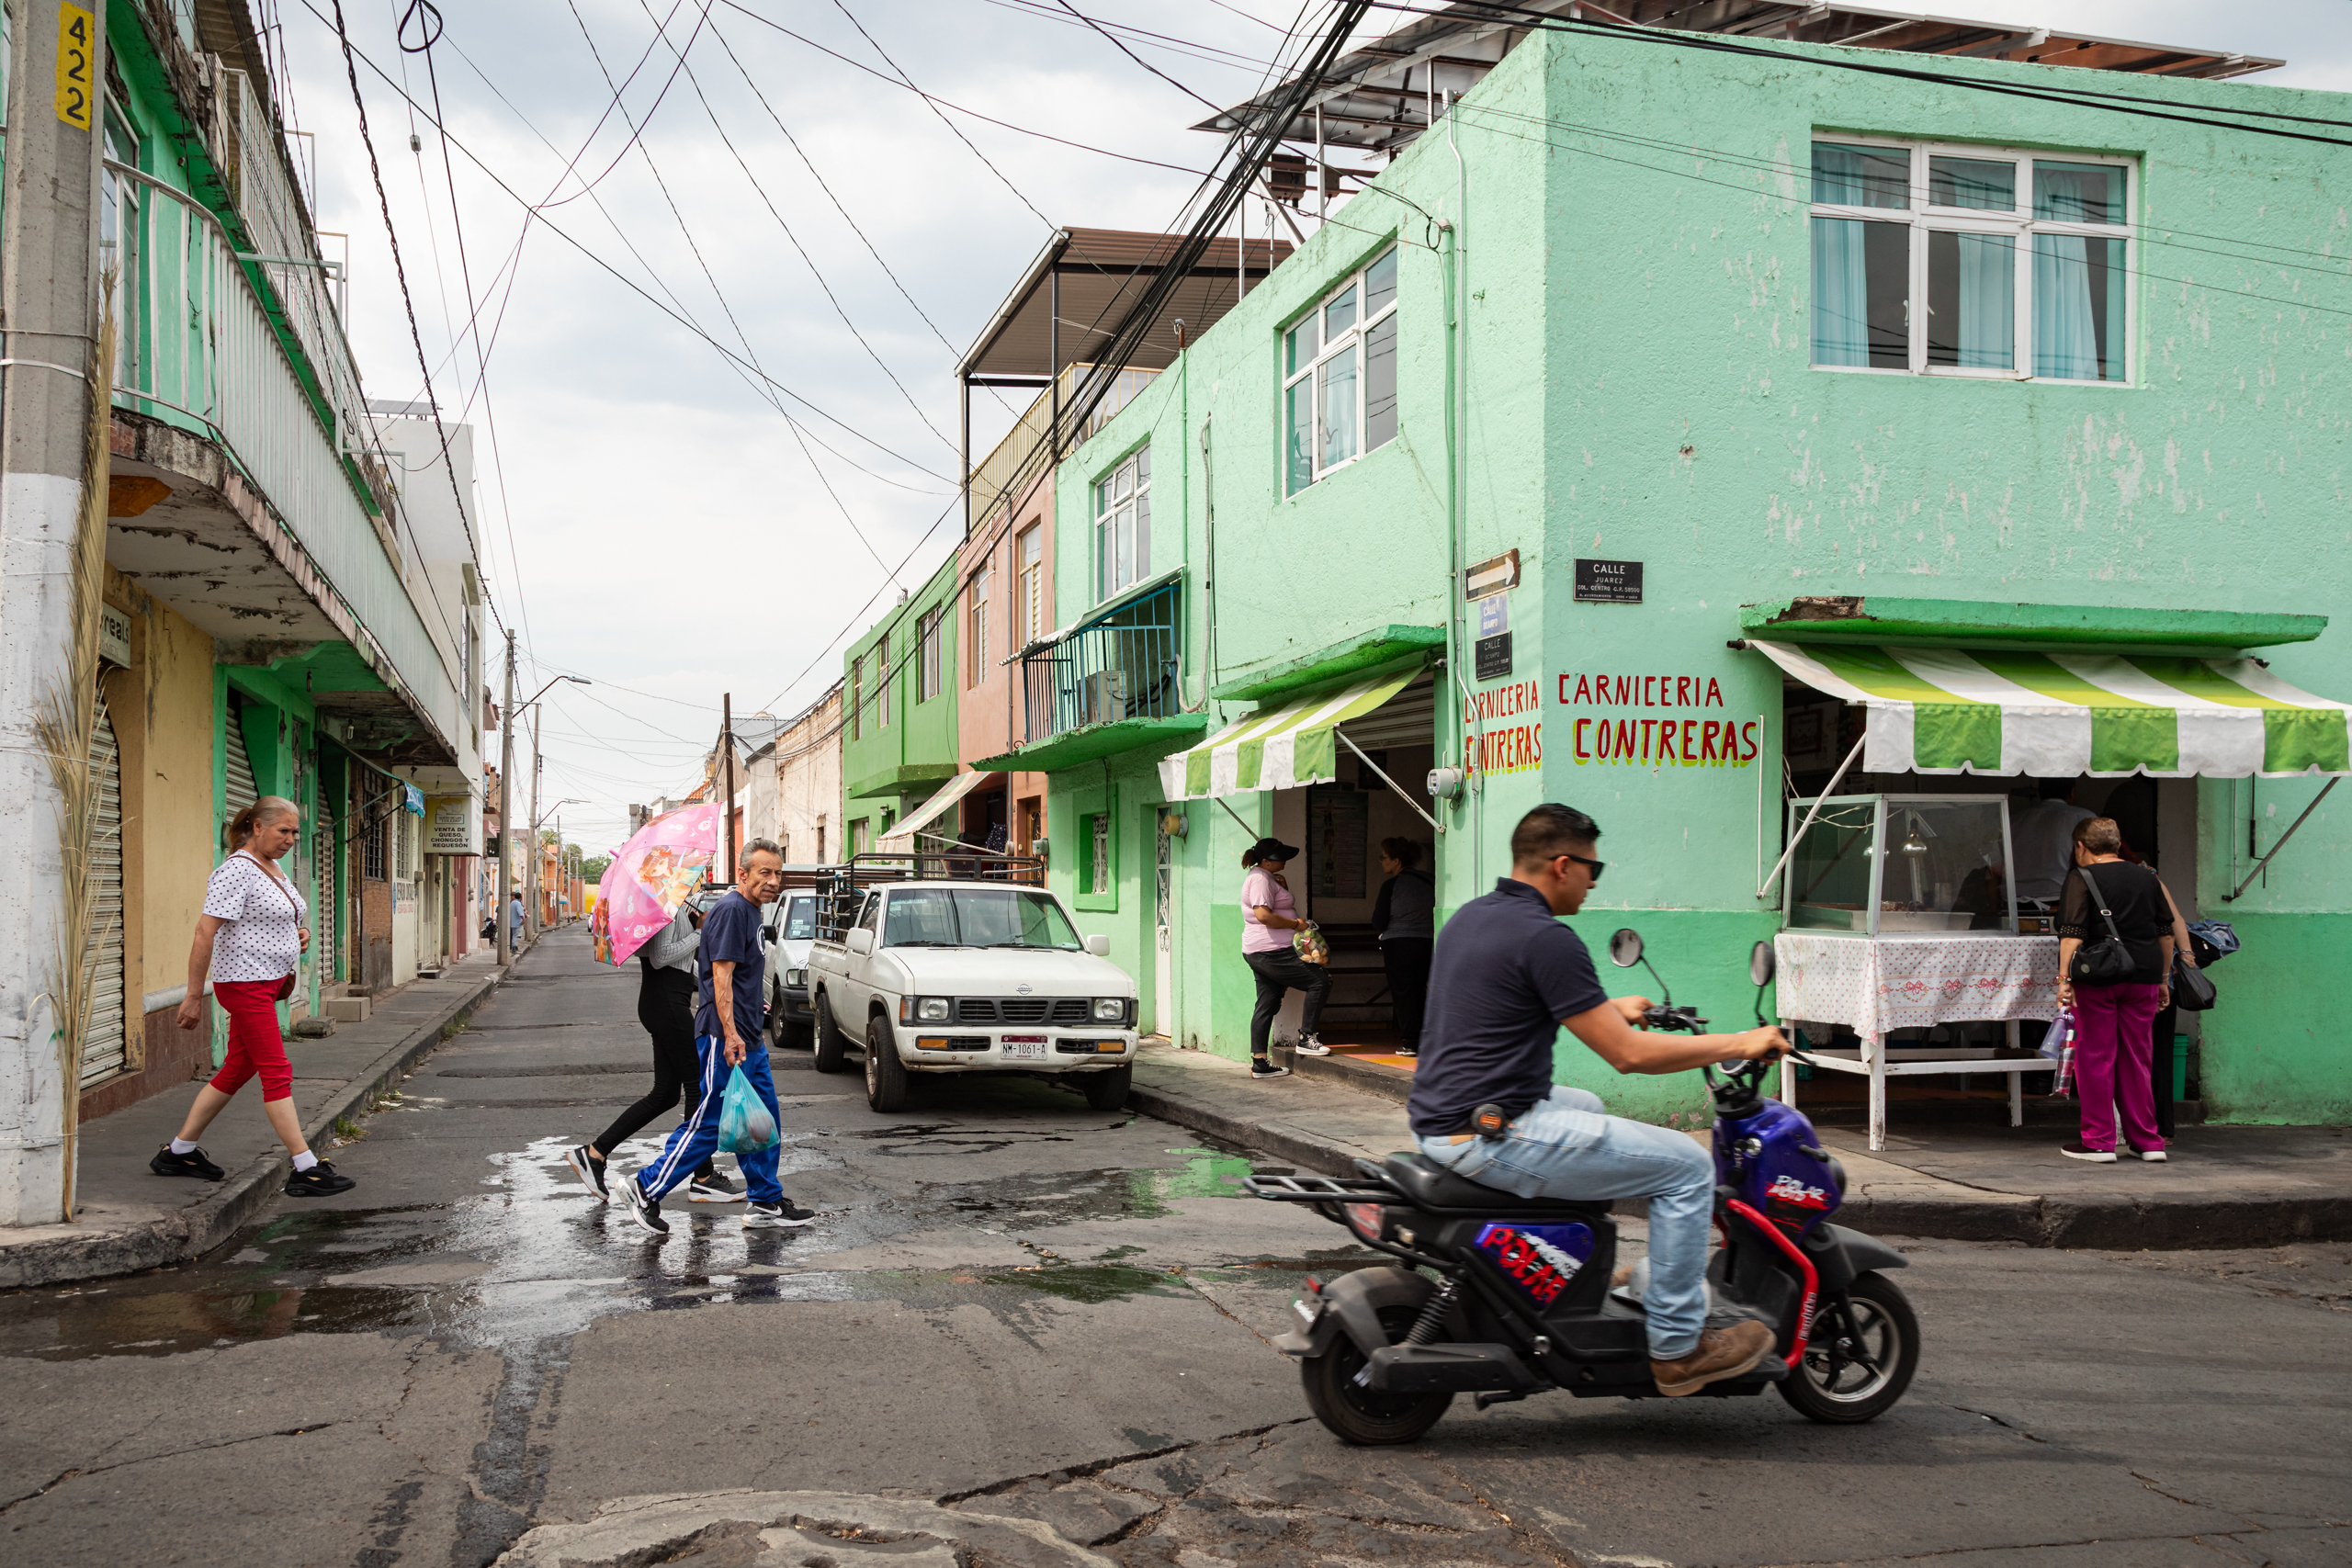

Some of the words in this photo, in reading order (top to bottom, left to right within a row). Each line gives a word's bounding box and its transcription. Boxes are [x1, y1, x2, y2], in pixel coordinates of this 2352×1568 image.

[67, 16, 86, 121] 422
[1593, 564, 1625, 574] CALLE
[1483, 604, 1497, 617] CALLE
[1483, 618, 1498, 631] OCAMPO
[1484, 638, 1501, 650] CALLE
[1485, 651, 1500, 660] OCAMPO
[1558, 673, 1724, 707] CARNICERIA
[1573, 718, 1758, 766] CONTRERAS
[1466, 723, 1542, 778] CNTRERAS
[1002, 1043, 1046, 1055] NM-1061-A
[1481, 1227, 1567, 1303] POLAR
